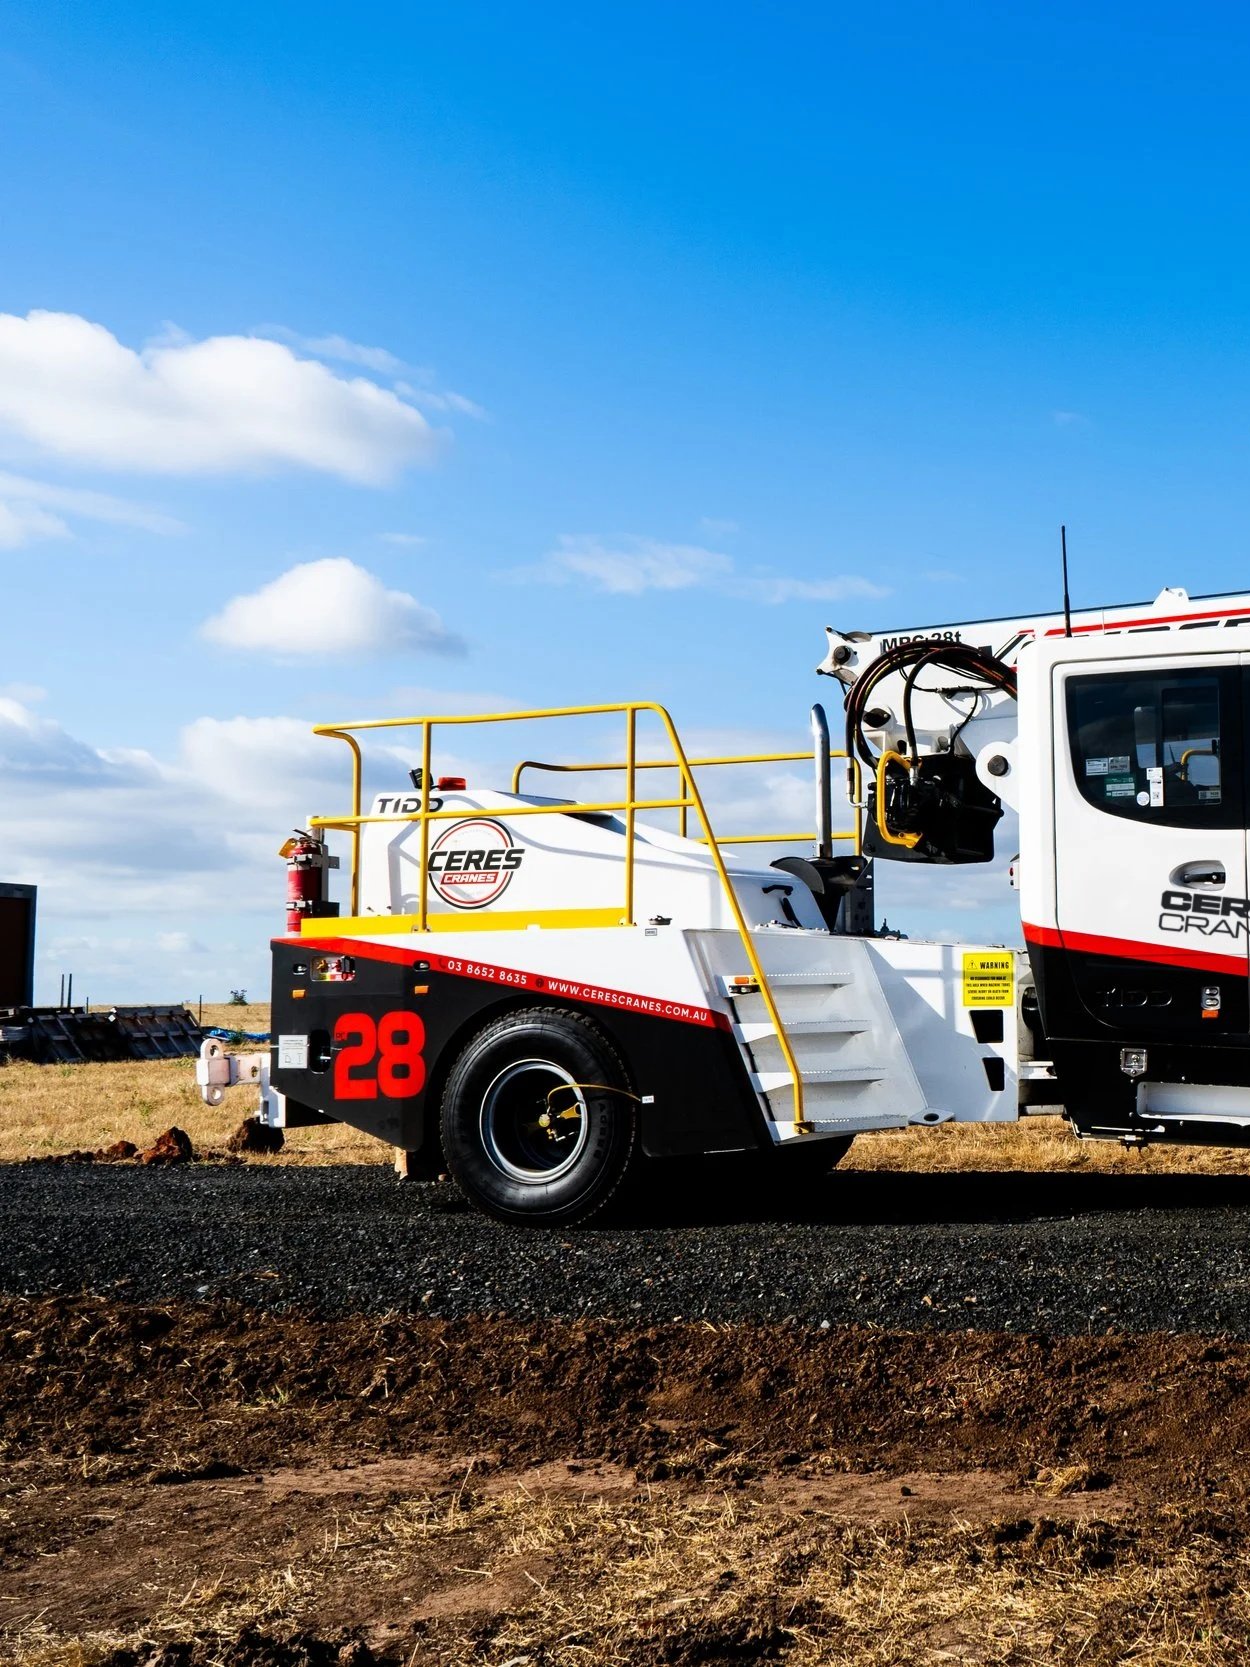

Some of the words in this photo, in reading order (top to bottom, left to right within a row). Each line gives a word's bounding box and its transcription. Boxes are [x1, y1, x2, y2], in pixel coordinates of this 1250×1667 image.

[378, 797, 443, 814] TIDD
[428, 848, 526, 872] CERES
[443, 872, 496, 884] CRANES
[979, 961, 1010, 970] WARNING
[447, 960, 462, 972] 03
[466, 964, 495, 978] 8652
[499, 970, 527, 985] 8635
[548, 980, 707, 1021] WWW.CERESCRANES.COM.AU
[334, 1011, 425, 1099] 28
